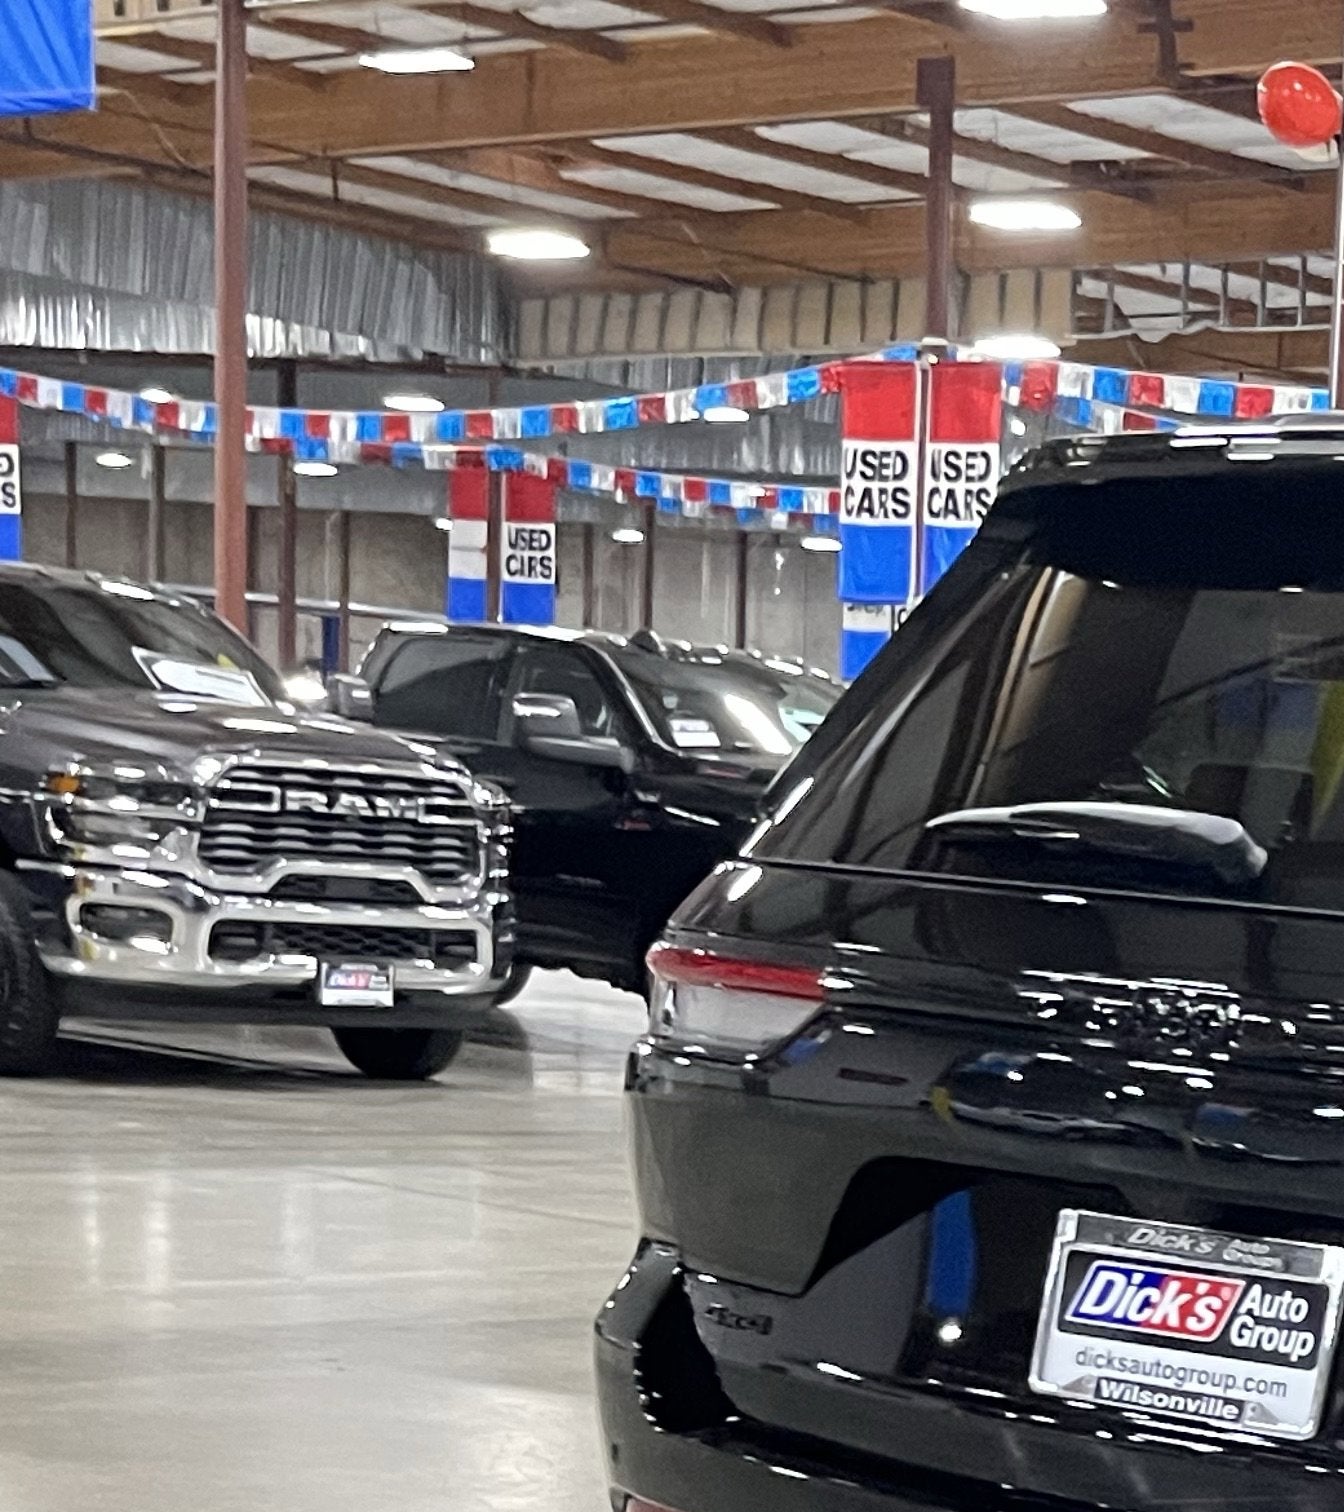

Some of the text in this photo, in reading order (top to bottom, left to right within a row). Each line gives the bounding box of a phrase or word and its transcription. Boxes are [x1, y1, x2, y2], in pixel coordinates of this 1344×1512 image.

[844, 448, 909, 482] USED
[930, 448, 992, 483] USED
[843, 485, 911, 519] CARS
[927, 486, 992, 521] CARS
[507, 525, 552, 551] USED
[1127, 1227, 1217, 1254] Dick's
[1078, 1268, 1224, 1332] Dick's
[1236, 1283, 1309, 1324] Auto
[1229, 1314, 1316, 1363] Group
[1074, 1346, 1288, 1399] dicksautogroup.com
[1100, 1379, 1241, 1421] Wilsonville
